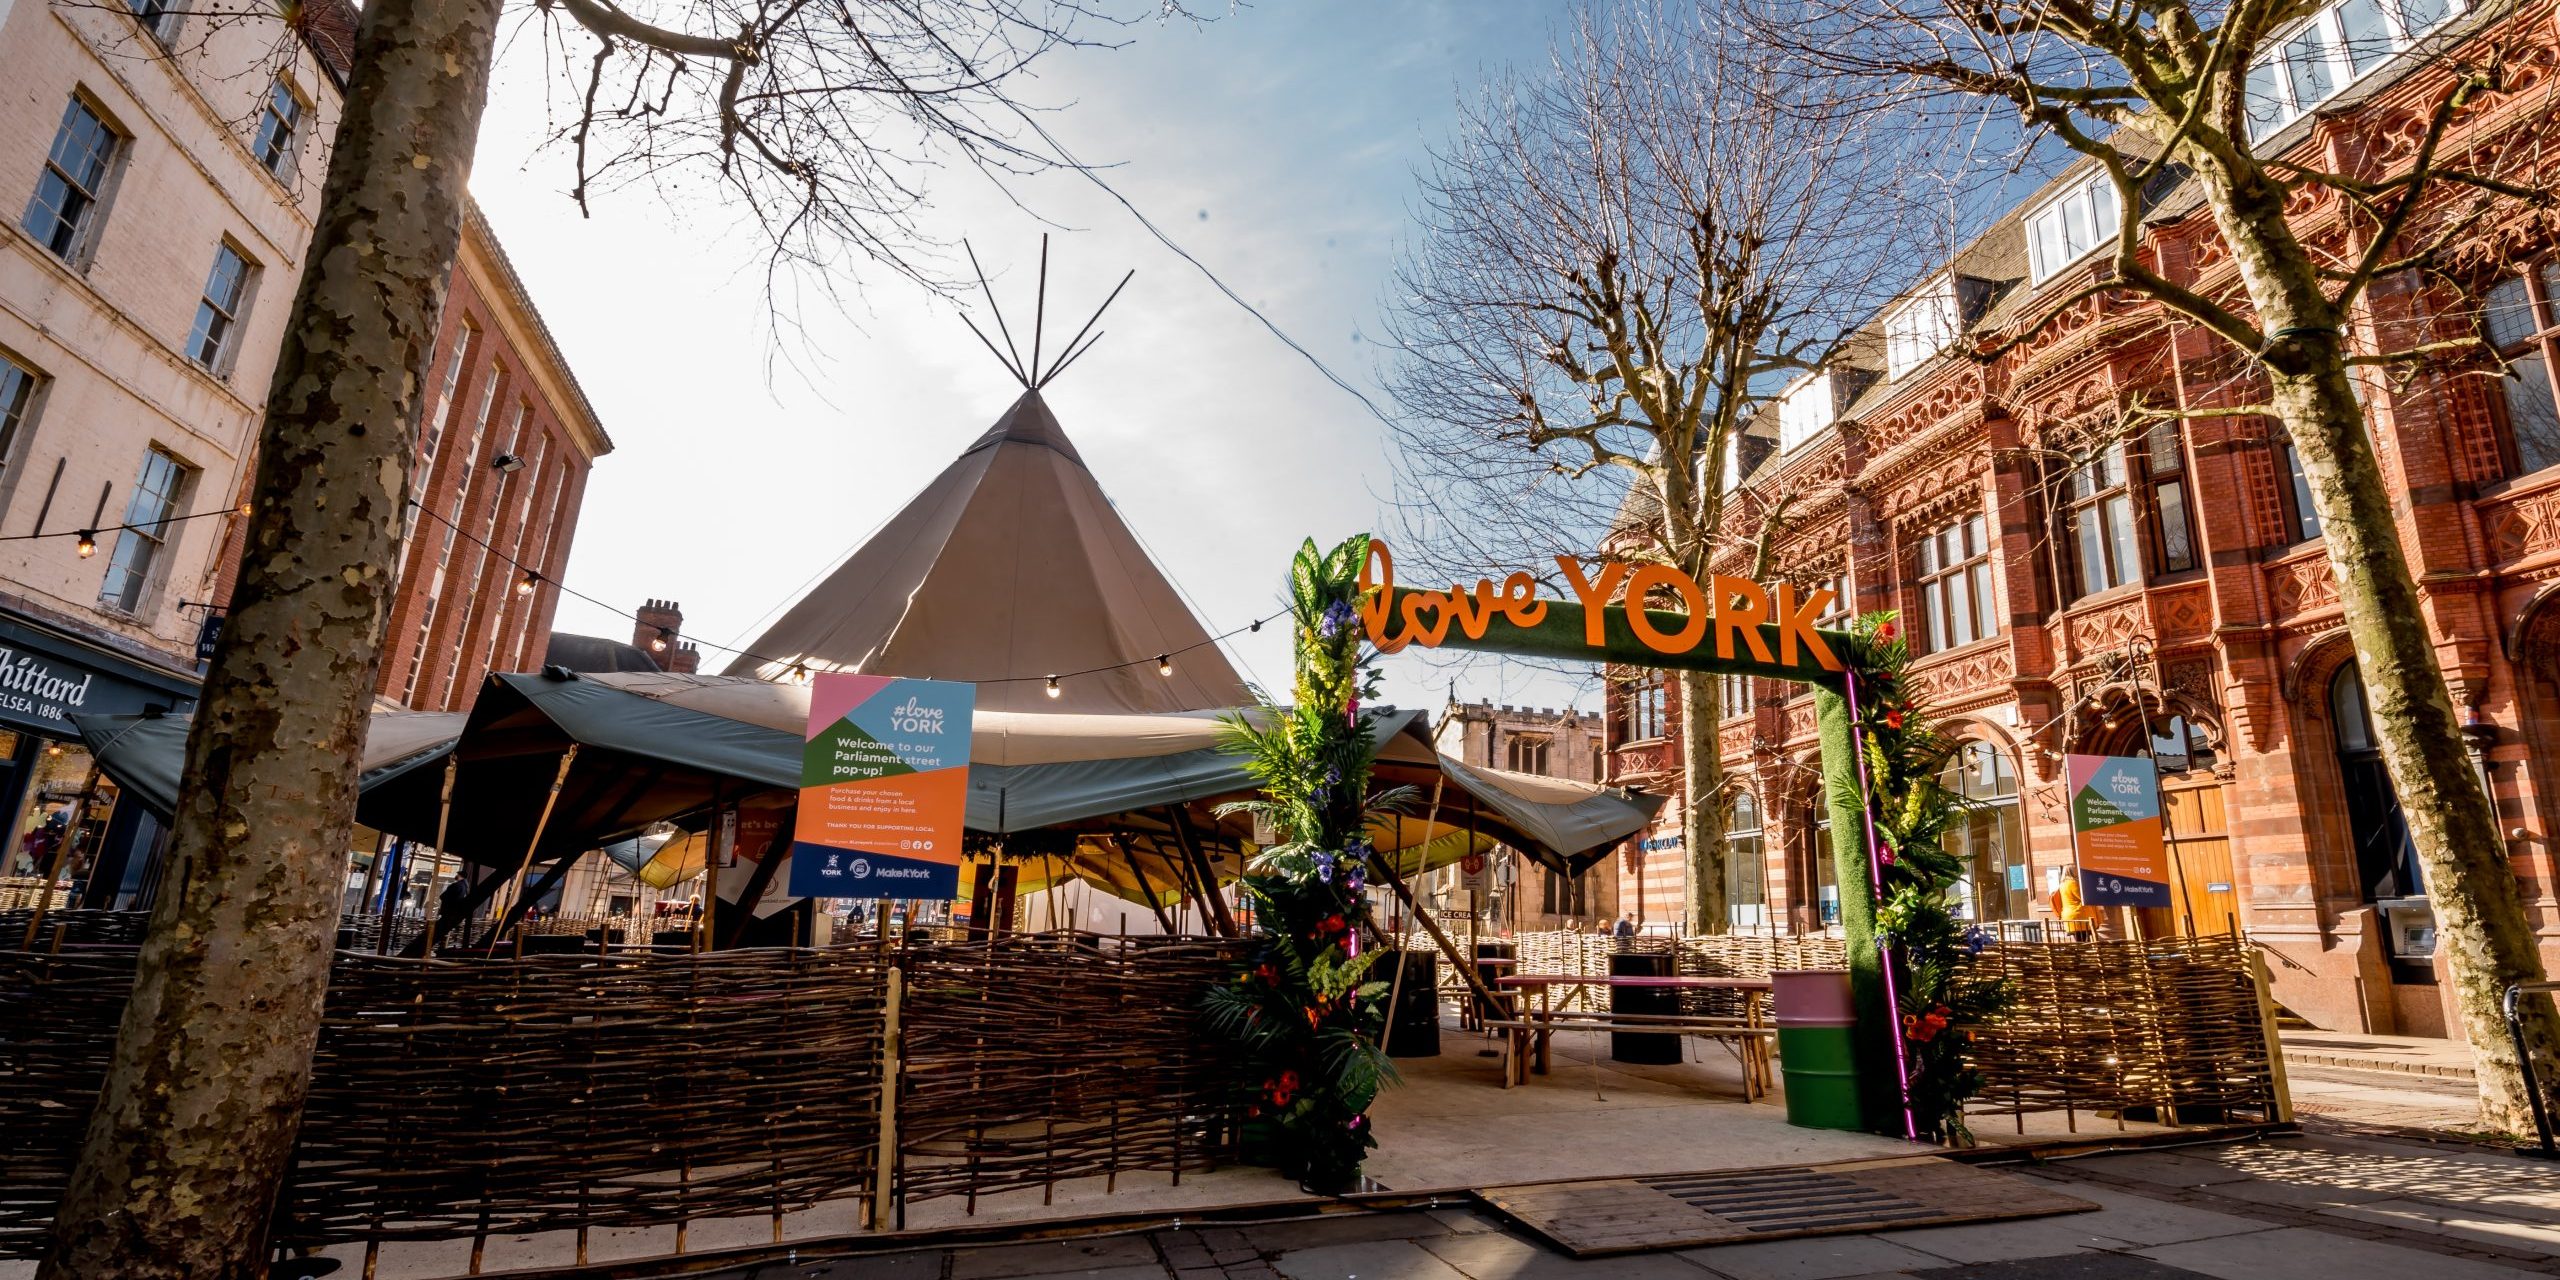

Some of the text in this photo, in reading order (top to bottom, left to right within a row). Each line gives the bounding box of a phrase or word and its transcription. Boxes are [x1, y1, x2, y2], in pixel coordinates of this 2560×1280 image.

[1358, 538, 1846, 673] love YORK
[0, 647, 92, 707] hittard
[37, 703, 63, 721] 1886
[894, 696, 944, 719] #love
[890, 716, 944, 735] YORK
[837, 737, 935, 753] Welcome to our
[835, 751, 941, 767] Parliament street
[833, 765, 883, 778] pop-up!
[830, 787, 861, 795] Purchase
[2111, 784, 2141, 794] YORK
[2086, 798, 2117, 807] Welcome
[828, 803, 857, 811] business
[859, 804, 871, 812] and
[873, 806, 891, 814] enjoy
[2087, 807, 2123, 816] Parliament
[741, 820, 761, 829] et's
[2088, 817, 2115, 825] pop-up!
[876, 824, 914, 832] SUPPORTING
[1648, 836, 1685, 850] BARCLAY
[821, 868, 842, 876] YORK
[1440, 910, 1472, 919] ICE CREA
